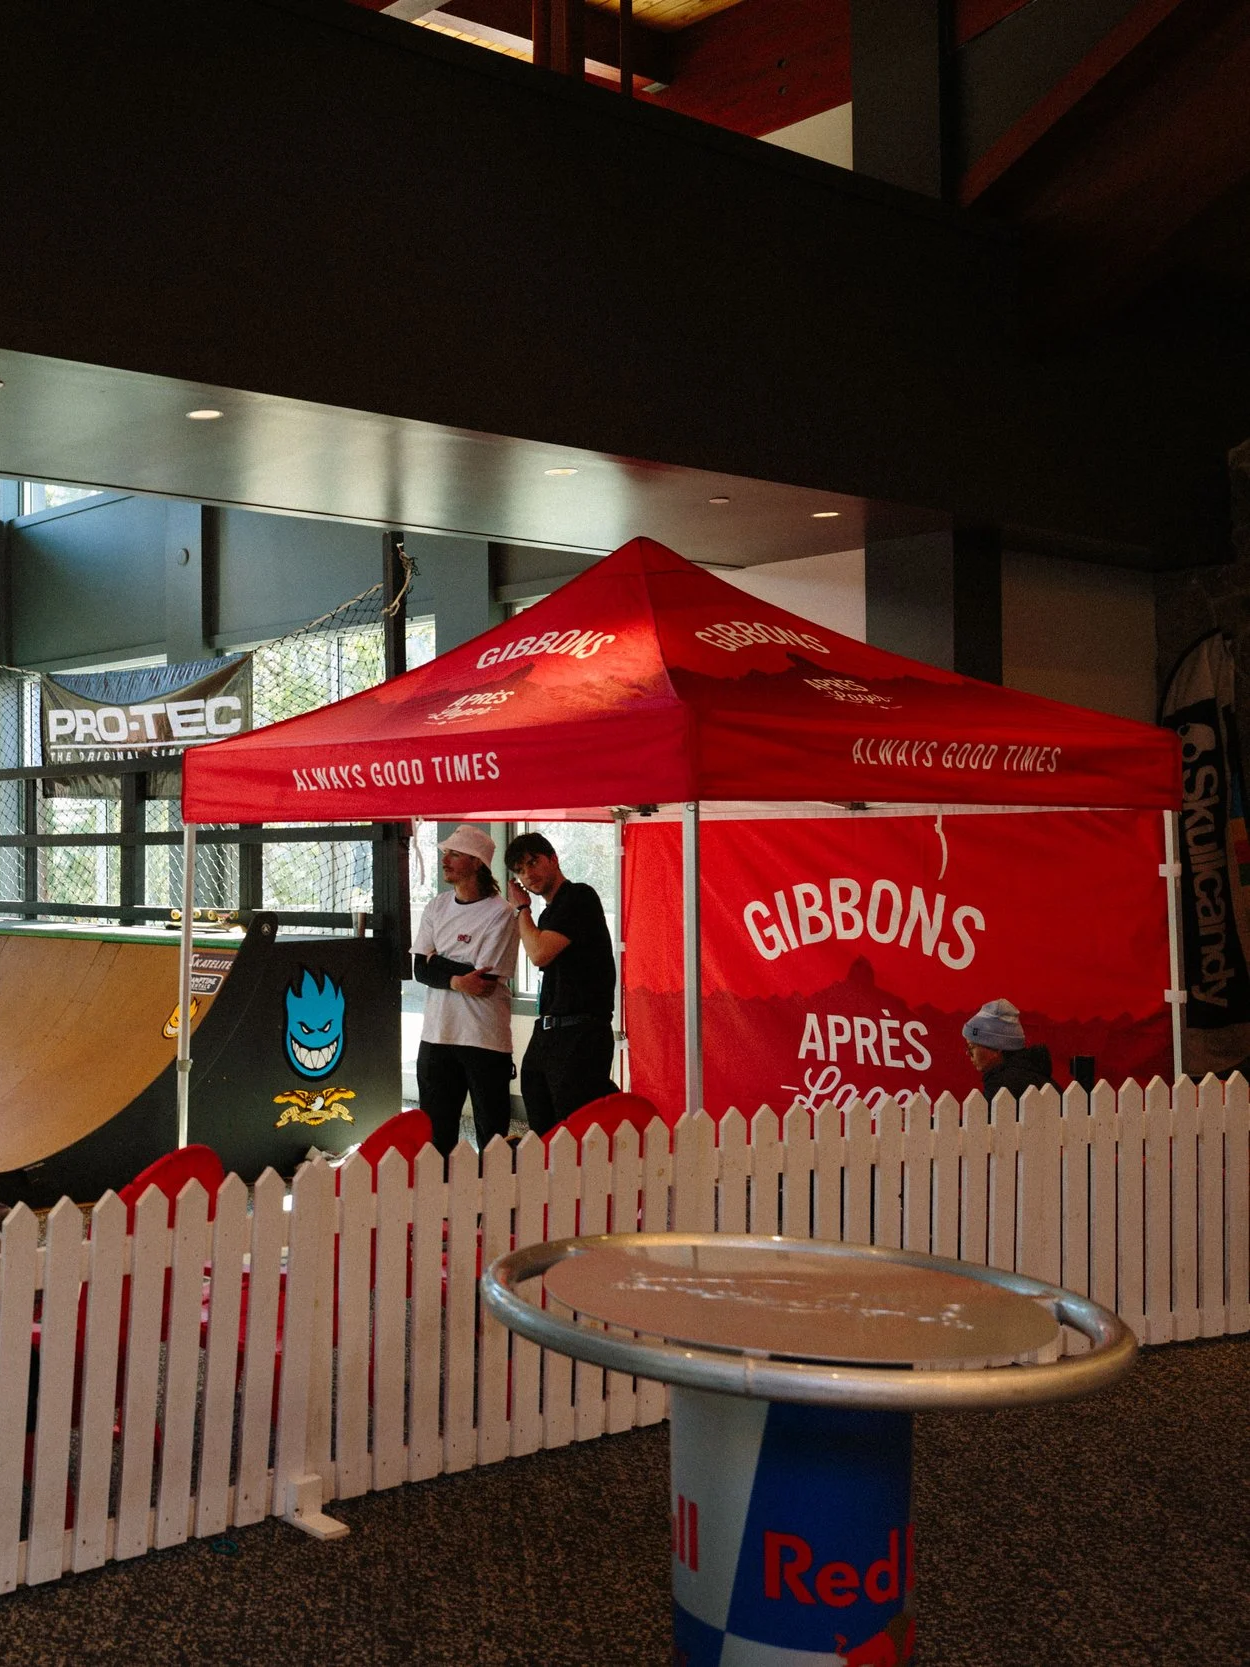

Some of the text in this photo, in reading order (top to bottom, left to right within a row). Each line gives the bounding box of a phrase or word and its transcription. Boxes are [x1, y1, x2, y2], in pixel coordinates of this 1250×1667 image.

[476, 629, 615, 670] GIBBONS
[694, 620, 831, 655] GIBBONS
[50, 751, 72, 762] THE
[292, 751, 500, 792] ALWAYS GOOD TIMES
[852, 738, 1062, 773] ALWAYS GOOD TIMES
[1181, 762, 1237, 1009] Skullcandy
[743, 878, 986, 970] GIBBONS
[798, 1009, 932, 1071] APRÈS
[763, 1526, 900, 1608] Red
